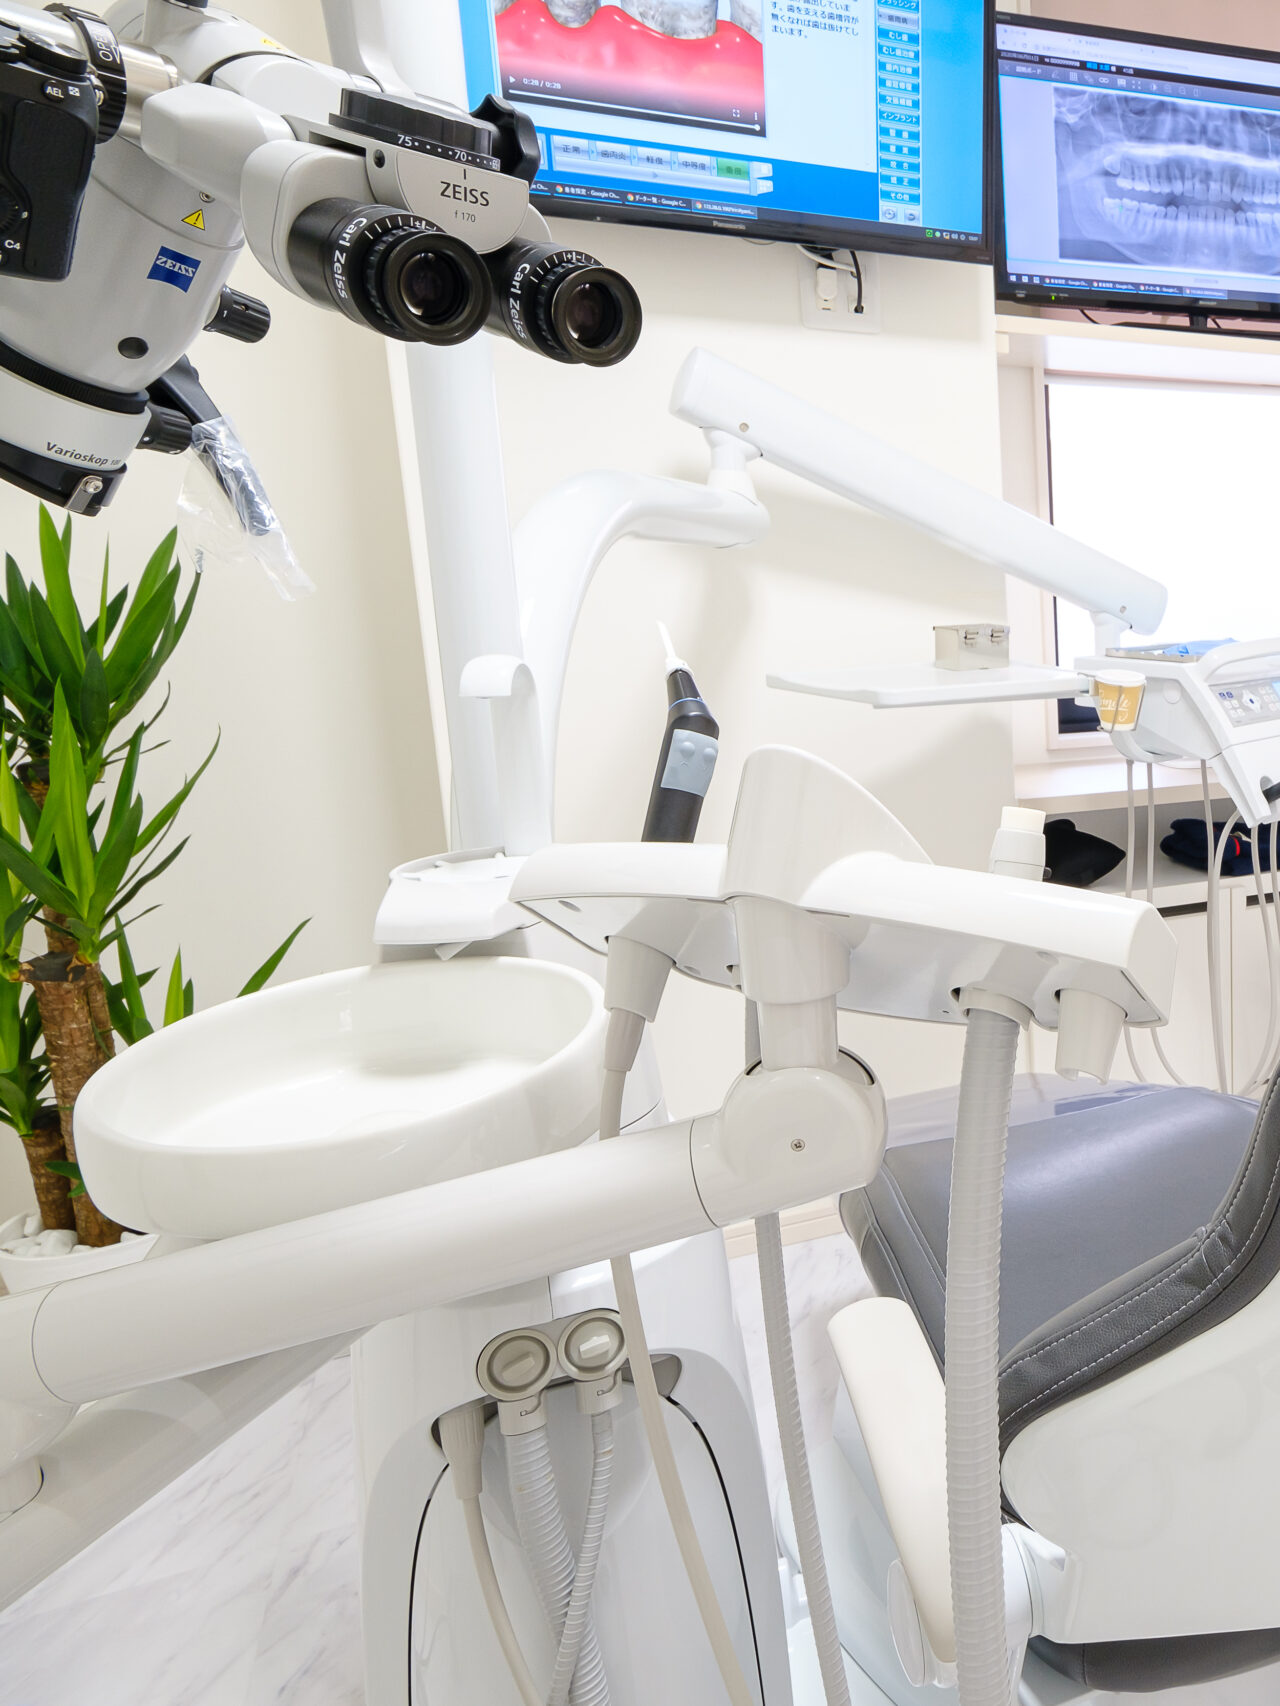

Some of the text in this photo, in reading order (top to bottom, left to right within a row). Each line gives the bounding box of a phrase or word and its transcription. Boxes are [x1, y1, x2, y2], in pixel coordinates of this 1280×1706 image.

[771, 25, 808, 39] まいます。
[46, 86, 64, 98] AEL
[882, 111, 917, 124] インプラント
[397, 134, 413, 147] 75
[454, 149, 467, 162] 70
[440, 181, 490, 207] ZEISS
[590, 190, 608, 198] Google
[461, 212, 476, 223] 170
[4, 239, 21, 250] C4
[156, 254, 196, 278] ZEISS
[333, 217, 368, 299] Carl Zeiss
[509, 263, 531, 340] Carl Zeiss
[46, 441, 109, 466] Varioskop
